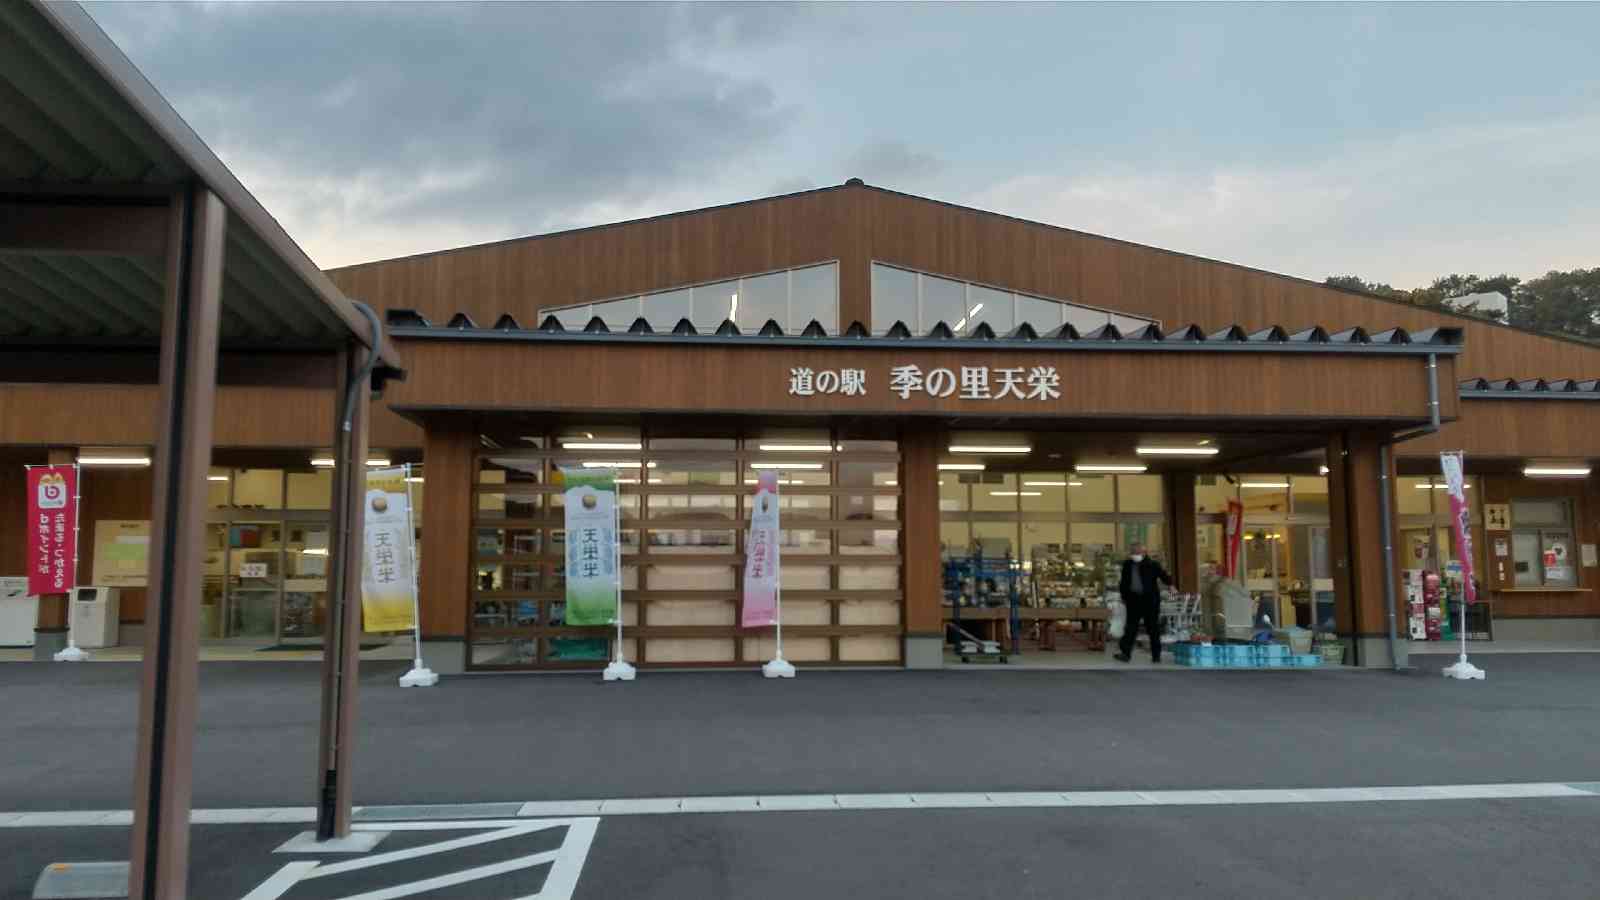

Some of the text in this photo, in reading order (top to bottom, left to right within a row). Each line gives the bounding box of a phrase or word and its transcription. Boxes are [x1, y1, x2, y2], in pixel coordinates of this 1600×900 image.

[788, 364, 1061, 400] 道の駅 季の里天栄
[582, 527, 599, 580] 天栄米
